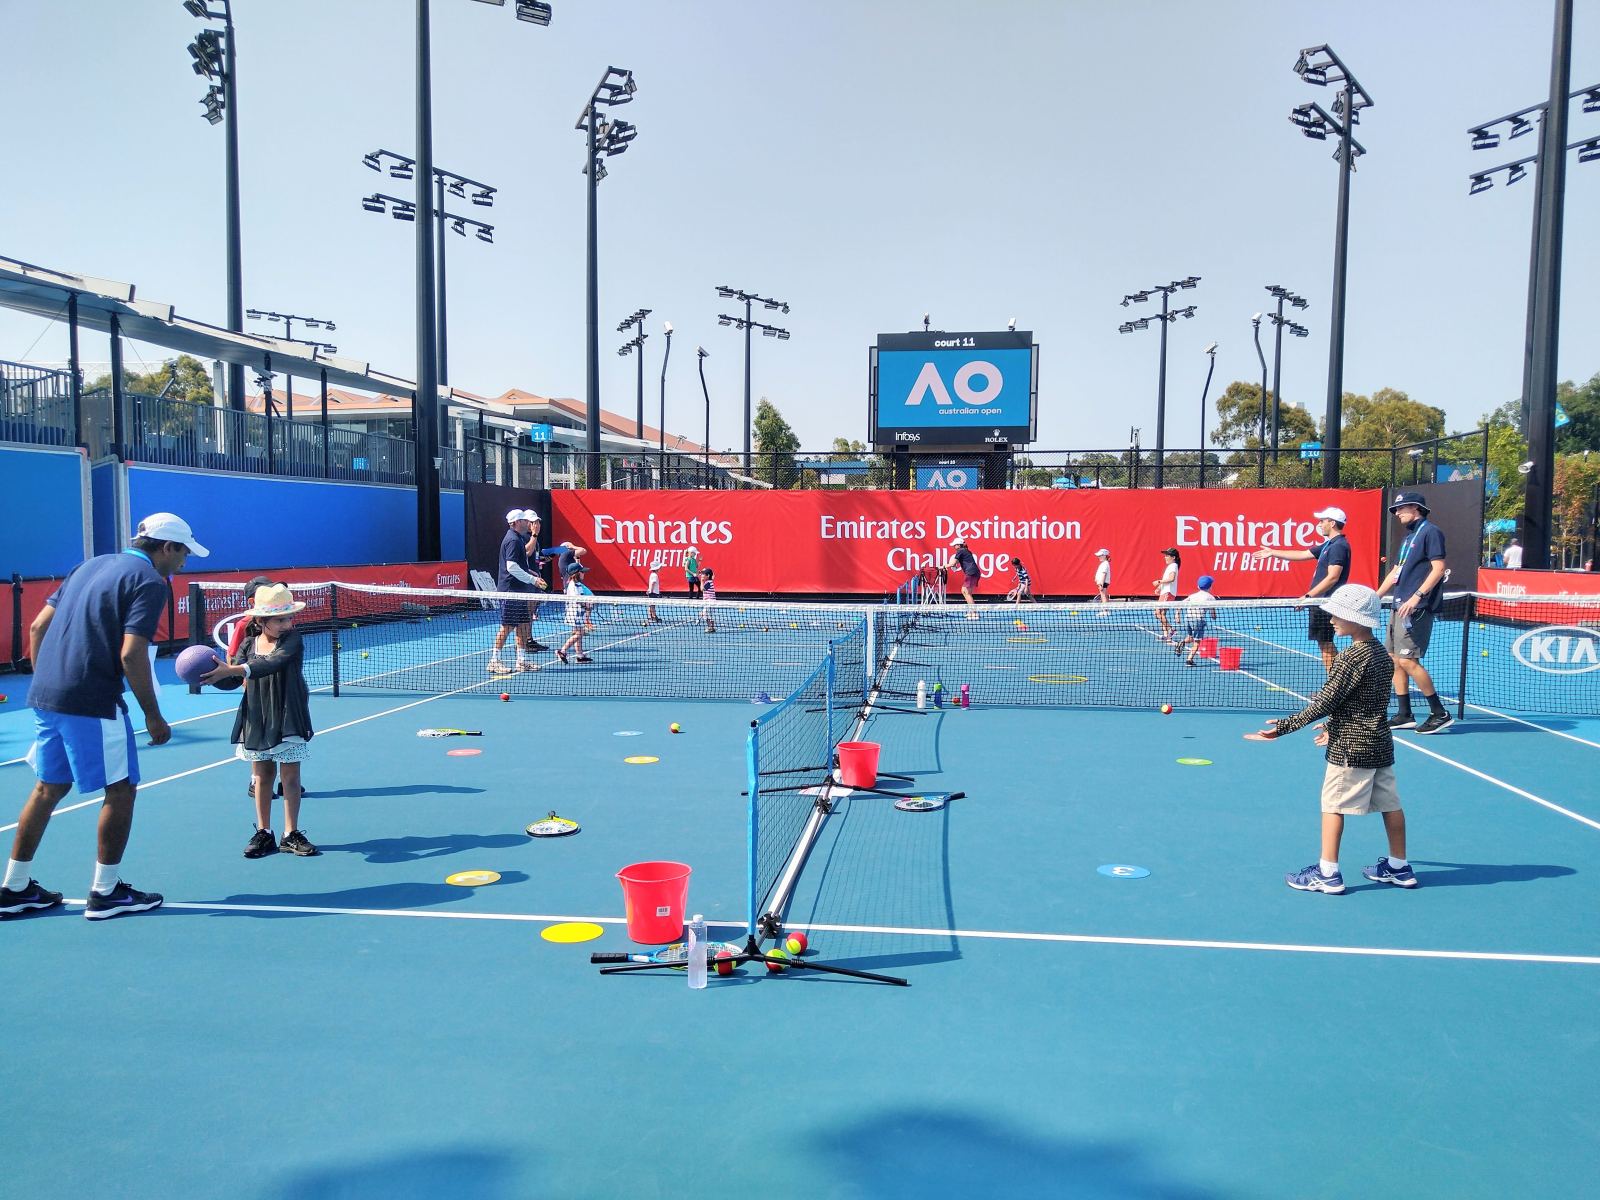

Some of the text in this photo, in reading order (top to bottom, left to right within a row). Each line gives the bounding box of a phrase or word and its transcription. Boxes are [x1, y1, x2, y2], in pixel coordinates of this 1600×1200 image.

[934, 337, 975, 347] court 11
[904, 360, 1004, 406] AO
[938, 407, 1002, 416] australian open
[534, 432, 546, 440] 11
[895, 432, 921, 441] Infosys
[927, 469, 968, 488] AO
[593, 514, 733, 545] Emirates
[820, 515, 1081, 540] Emirates Destination
[1175, 514, 1329, 547] Emirates
[629, 549, 698, 567] FLY BETTE
[887, 547, 1010, 578] Challge
[1213, 552, 1290, 572] FLY BETTER
[437, 573, 460, 586] Emirates
[1530, 636, 1599, 664] KIA
